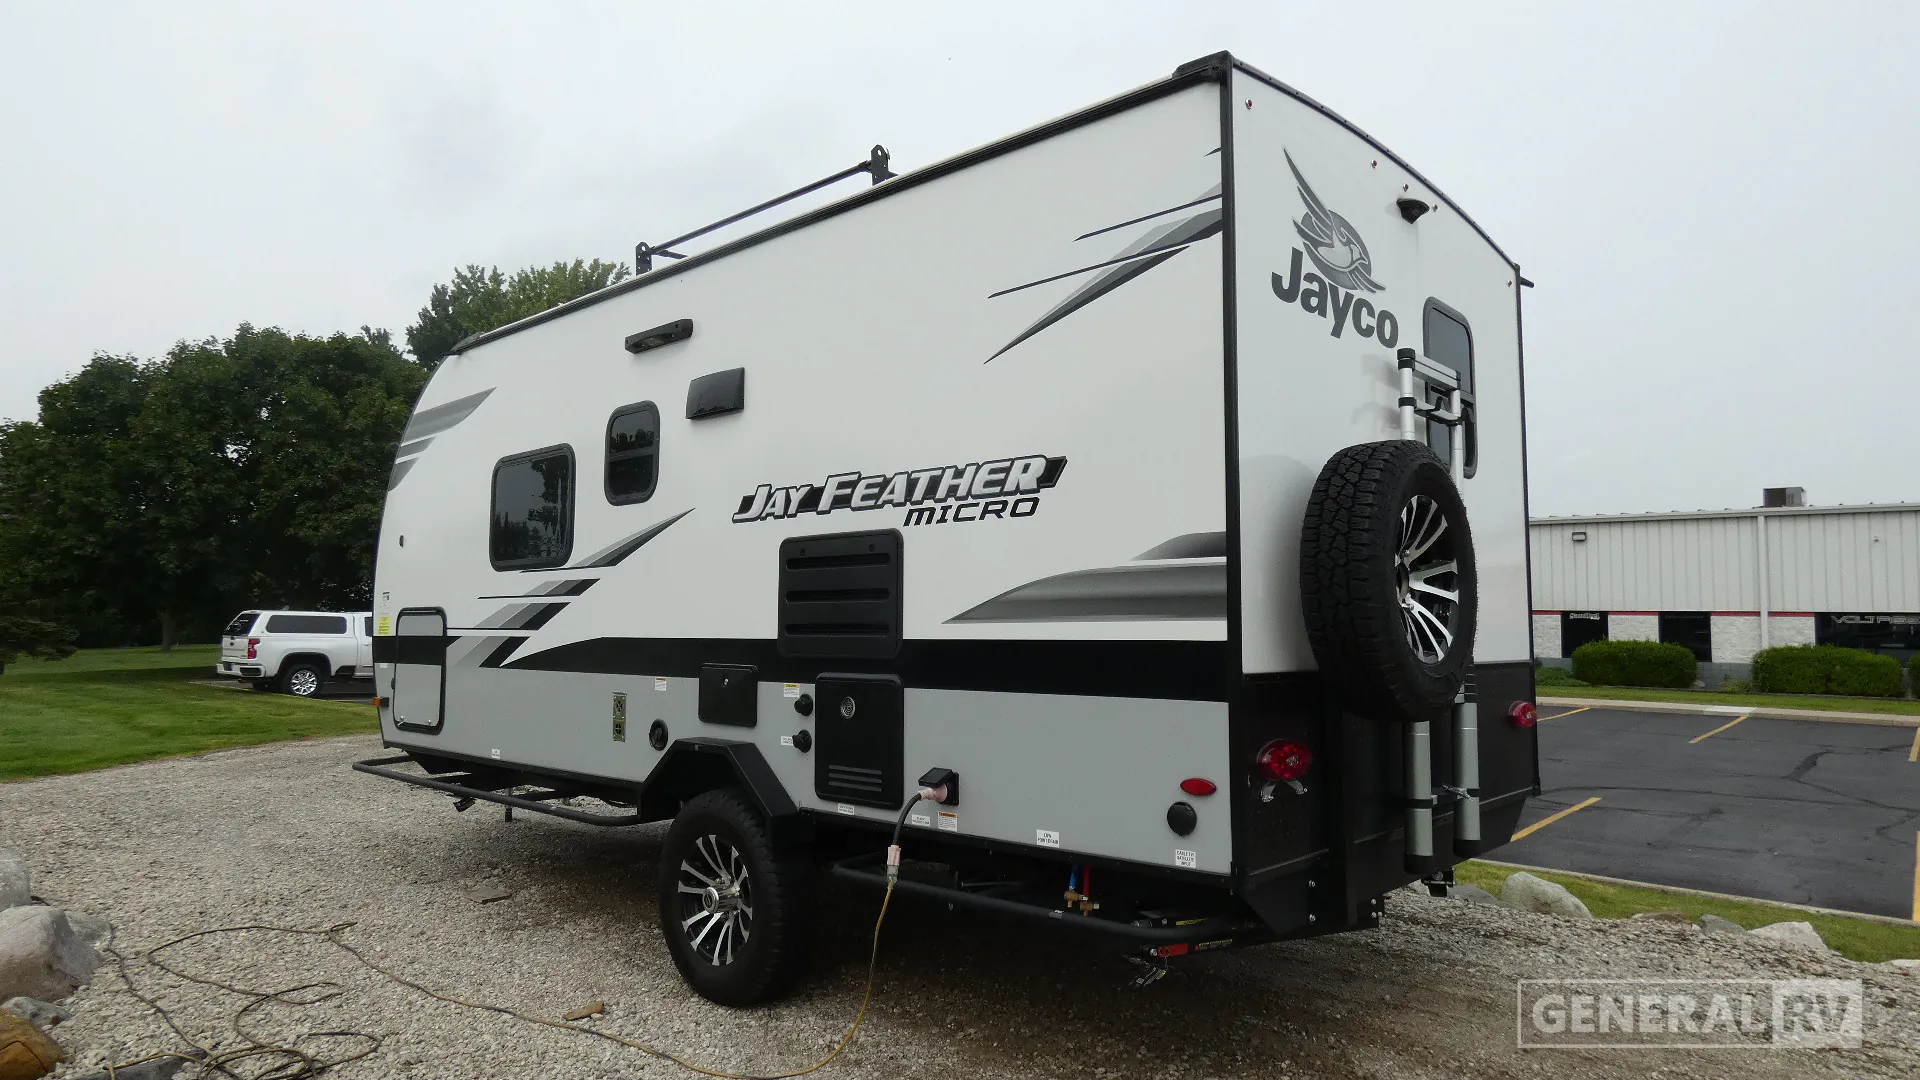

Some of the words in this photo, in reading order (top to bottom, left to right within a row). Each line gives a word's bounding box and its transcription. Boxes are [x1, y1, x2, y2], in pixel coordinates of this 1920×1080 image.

[1271, 246, 1399, 349] Jayco
[732, 484, 814, 524] JAY
[816, 454, 1048, 516] FEATHER
[903, 496, 1040, 527] MICRO
